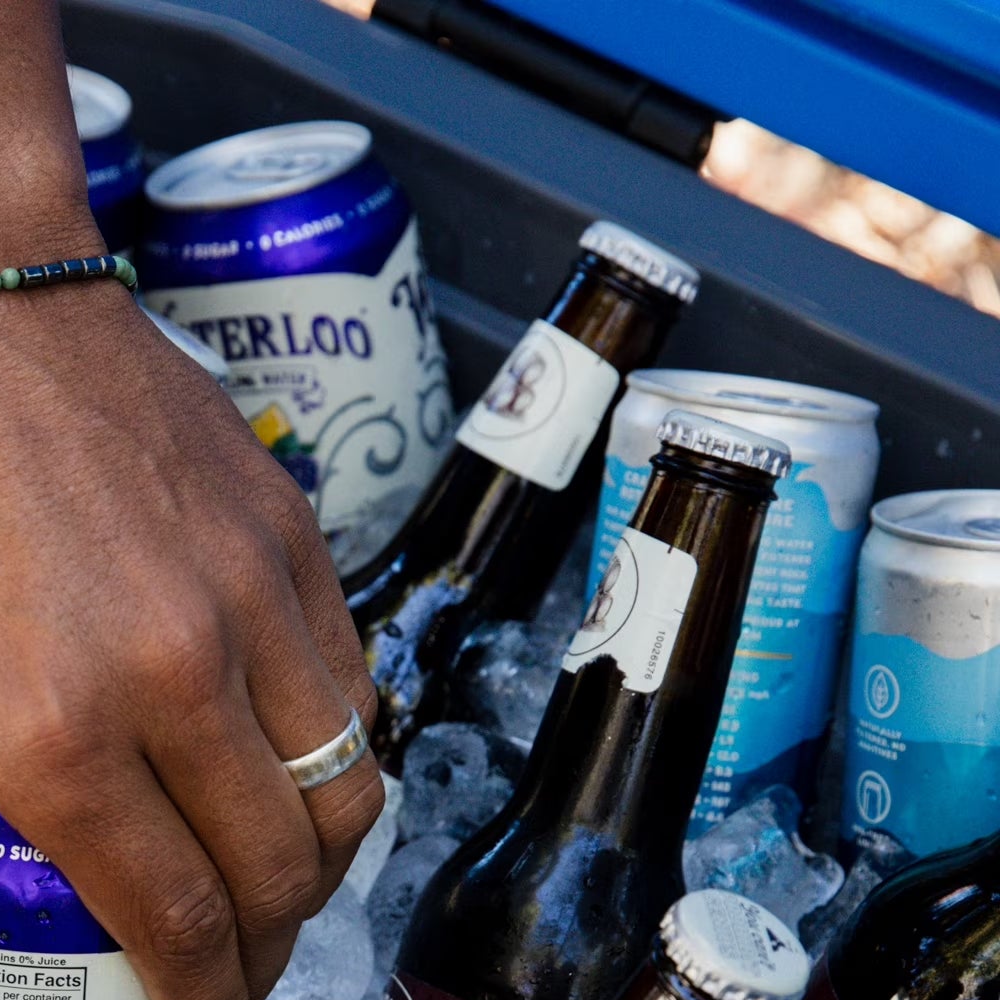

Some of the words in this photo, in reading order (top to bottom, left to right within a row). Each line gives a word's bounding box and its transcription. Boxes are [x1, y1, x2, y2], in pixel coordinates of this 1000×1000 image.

[644, 631, 666, 680] 10026576
[9, 845, 50, 863] SUG
[19, 956, 34, 965] 0%
[38, 957, 67, 966] Juice
[34, 973, 81, 987] Facts
[3, 991, 19, 1000] per
